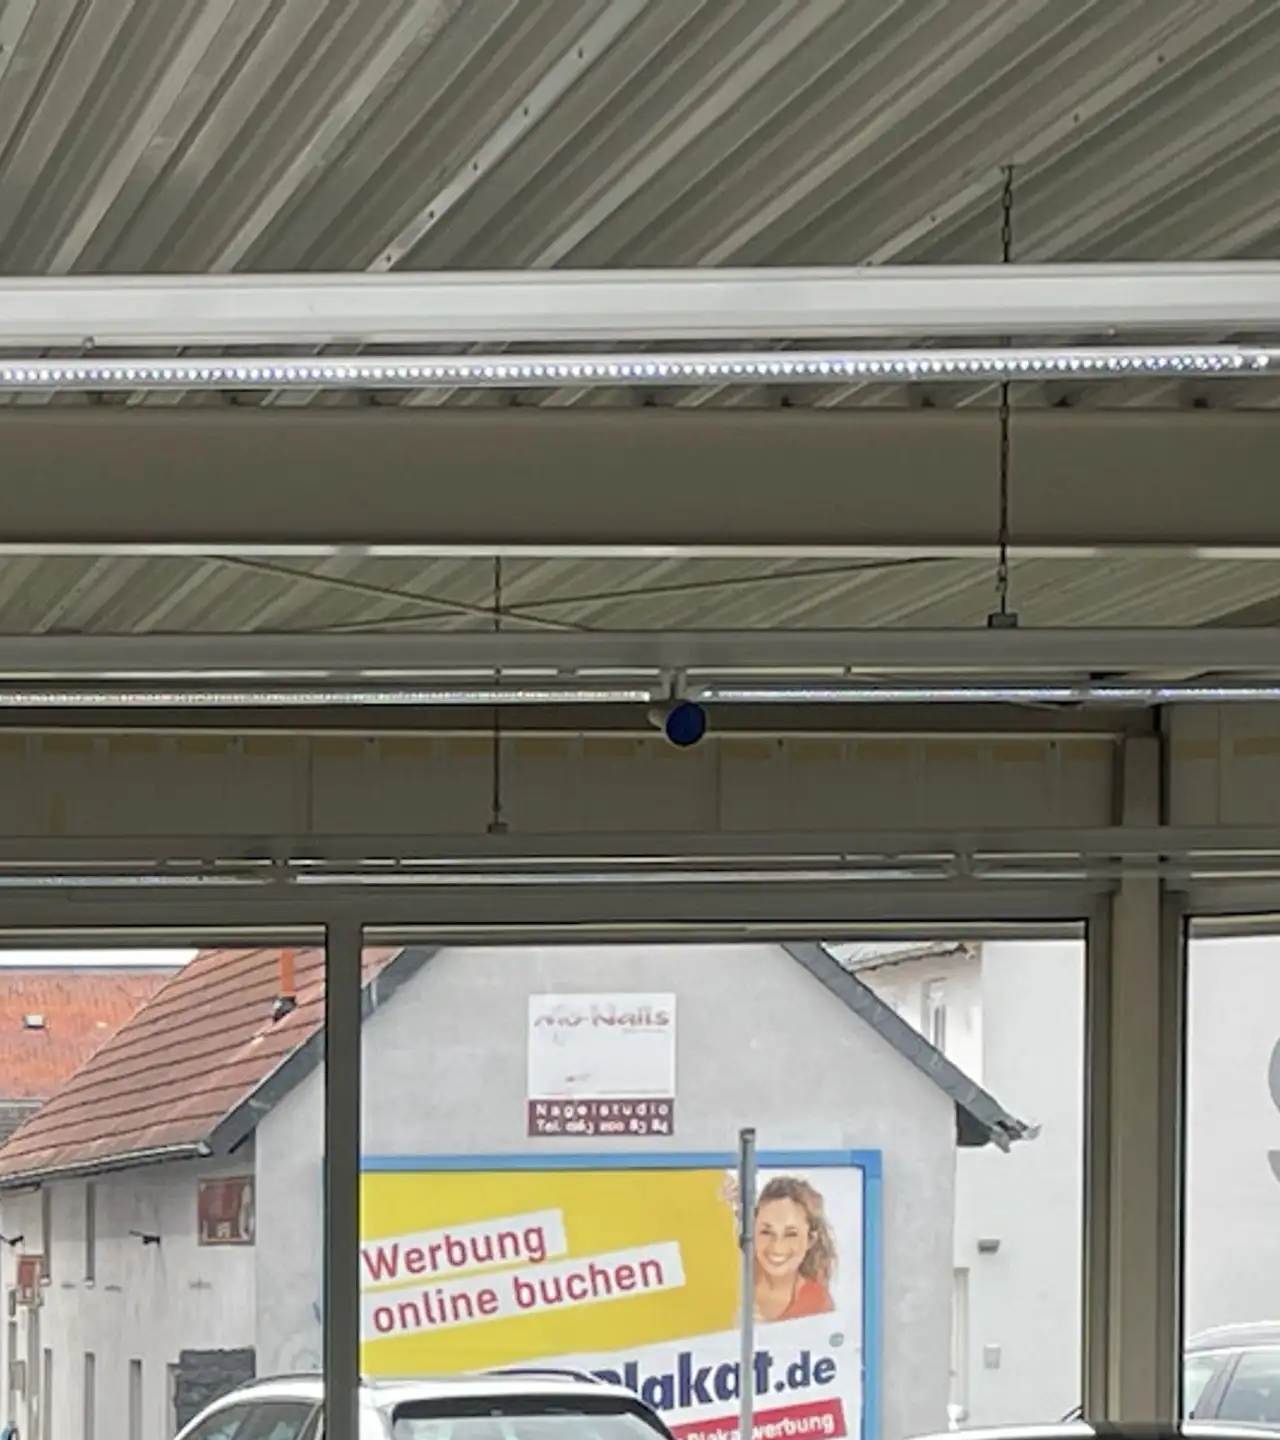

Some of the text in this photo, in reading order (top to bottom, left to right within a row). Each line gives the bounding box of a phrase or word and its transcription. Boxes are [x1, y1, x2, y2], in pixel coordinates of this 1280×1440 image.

[536, 1103, 669, 1118] Nagelstudio
[362, 1226, 545, 1281] Werbung
[373, 1259, 664, 1333] online buchen
